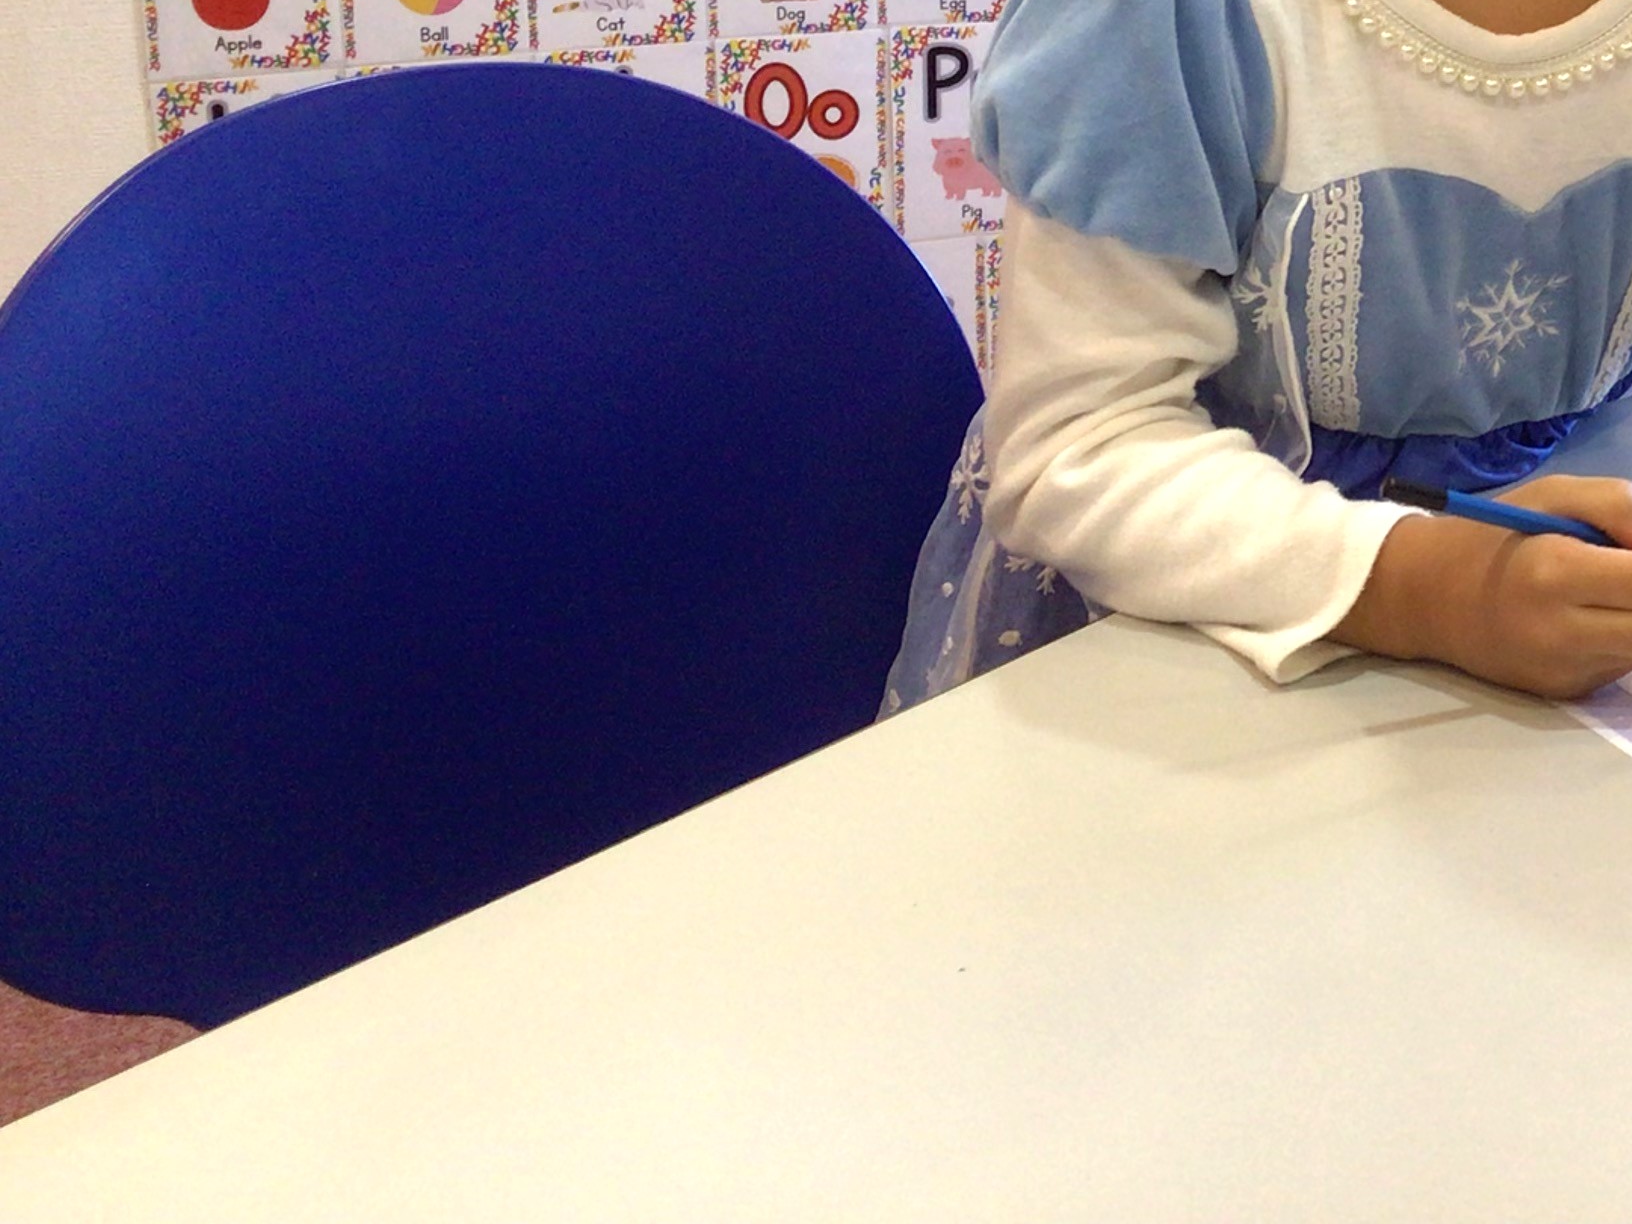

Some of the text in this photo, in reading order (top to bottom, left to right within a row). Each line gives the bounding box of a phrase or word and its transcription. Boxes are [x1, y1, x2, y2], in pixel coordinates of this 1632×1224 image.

[776, 6, 806, 23] Dog
[596, 16, 626, 33] Cat
[419, 26, 450, 43] Ball
[215, 35, 263, 54] Apple
[922, 43, 977, 123] P
[744, 62, 859, 140] Oo
[962, 204, 983, 220] Pig
